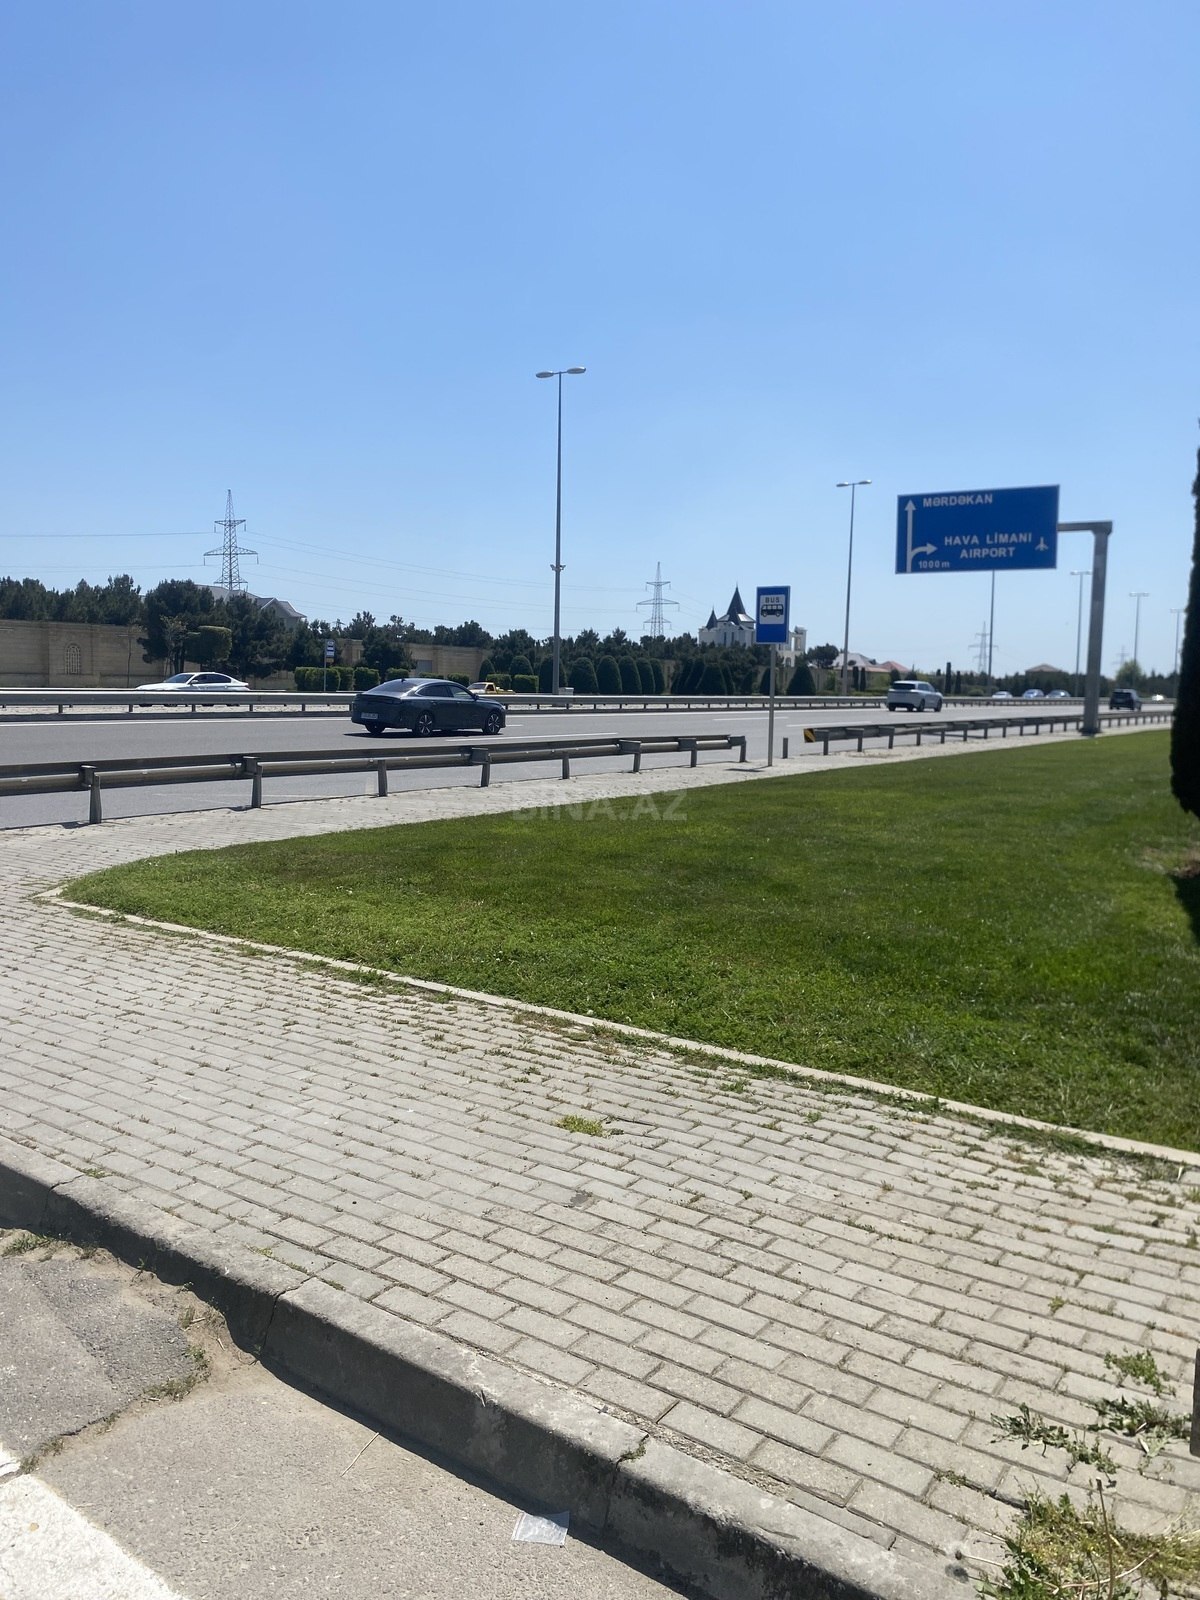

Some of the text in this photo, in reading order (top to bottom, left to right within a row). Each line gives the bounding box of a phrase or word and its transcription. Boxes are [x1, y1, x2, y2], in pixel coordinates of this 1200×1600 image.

[944, 532, 1032, 546] HAVA LİMANI
[960, 547, 1015, 559] AIRPORT
[918, 560, 950, 569] 1000 m
[765, 596, 780, 604] BUS
